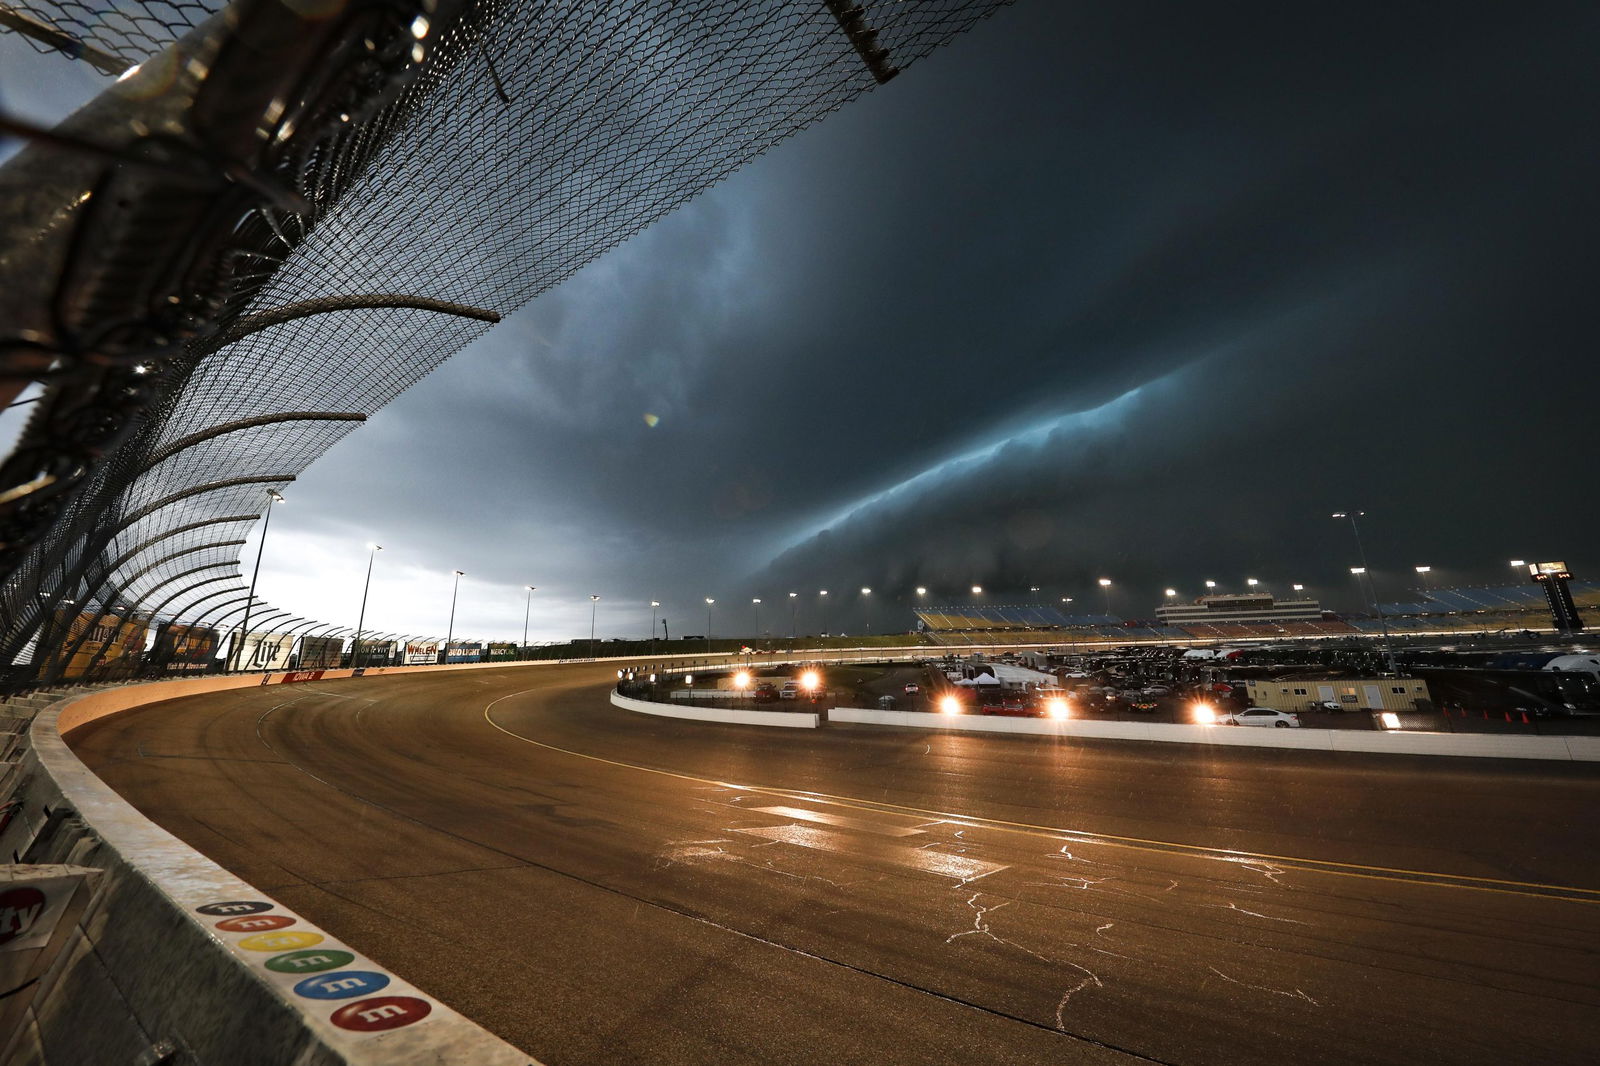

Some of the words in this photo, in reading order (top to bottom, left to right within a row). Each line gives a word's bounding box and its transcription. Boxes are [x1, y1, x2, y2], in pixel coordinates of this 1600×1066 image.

[253, 639, 281, 668] Lite
[407, 644, 437, 654] WHELEN
[463, 648, 480, 656] LIGHT
